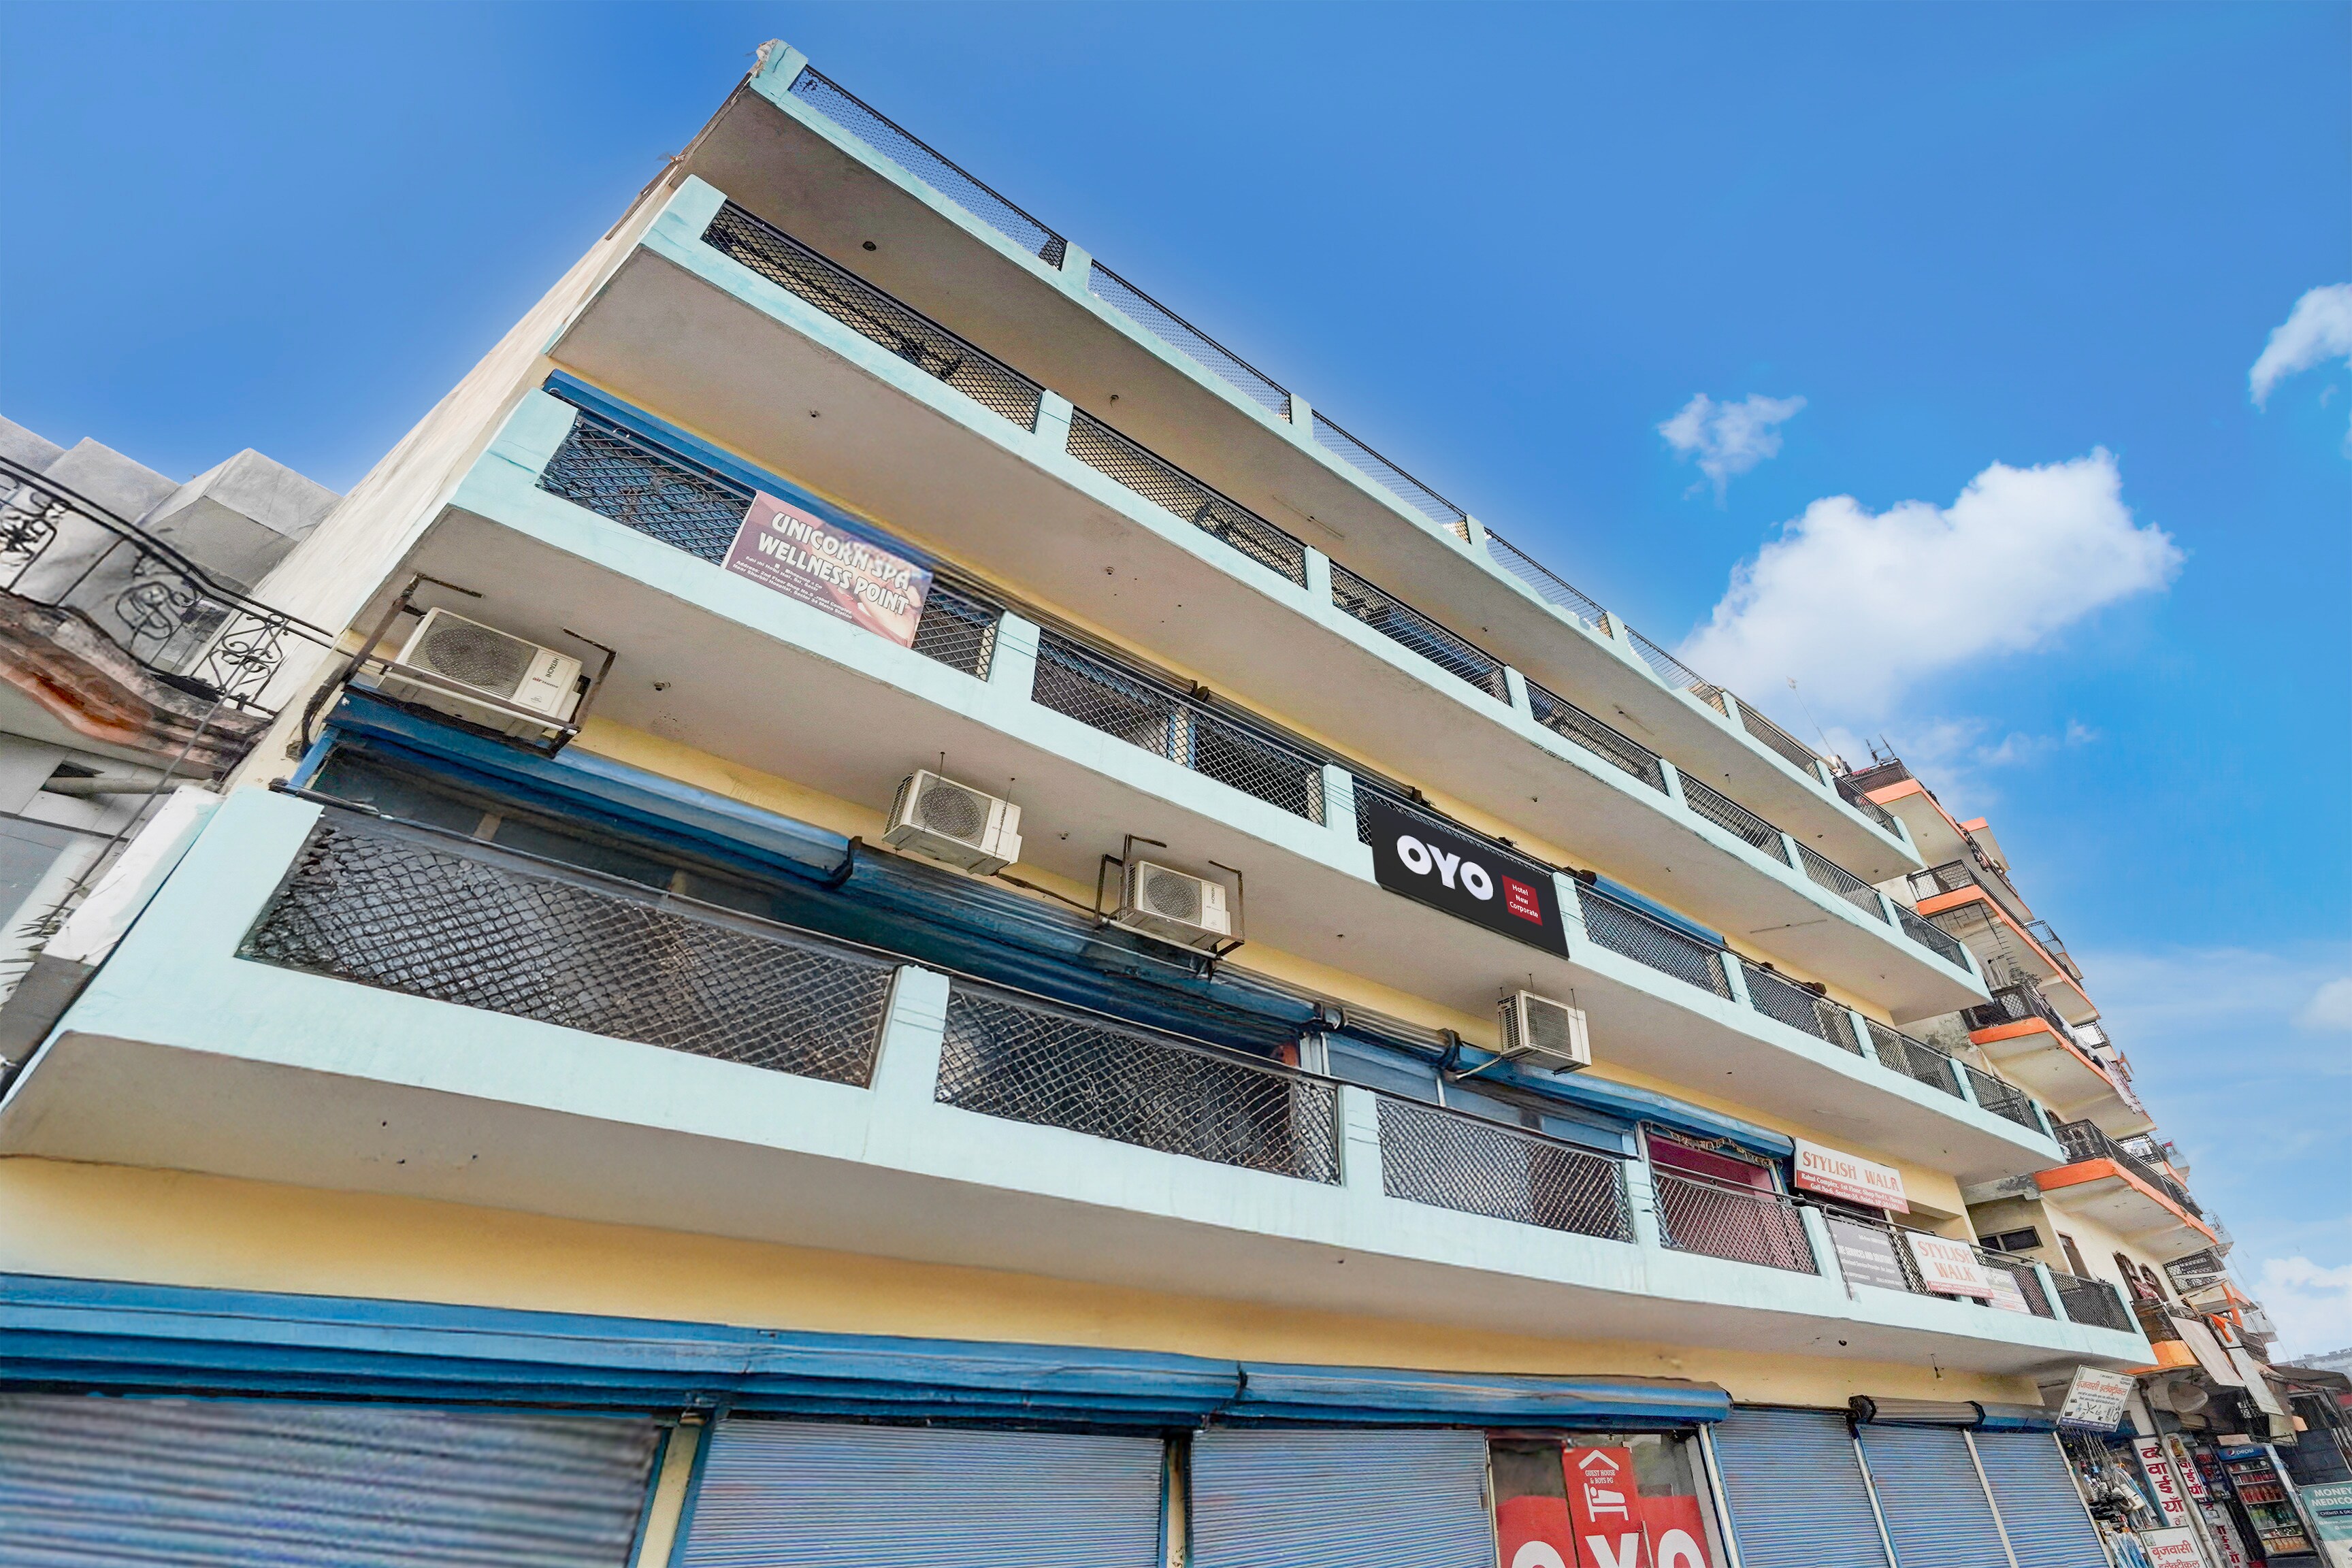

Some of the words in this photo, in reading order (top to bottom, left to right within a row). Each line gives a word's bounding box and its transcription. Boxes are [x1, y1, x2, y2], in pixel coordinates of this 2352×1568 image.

[772, 512, 870, 572] UNICORN
[871, 559, 911, 591] SPA
[758, 532, 853, 590] WELLNESS
[853, 576, 910, 615] POINT
[787, 582, 800, 591] Shop
[834, 608, 853, 619] Station
[545, 657, 560, 679] HITACHI
[1396, 835, 1494, 900] OYO
[1512, 884, 1529, 896] Hotel
[1515, 894, 1529, 905] New
[1509, 901, 1539, 918] Corporate
[1802, 1151, 1858, 1180] STYLISH
[1917, 1241, 1975, 1264] STYLISH
[1934, 1262, 1978, 1283] WALK
[2236, 1448, 2254, 1456] pepsi
[2314, 1487, 2352, 1497] MONEY
[2151, 1540, 2193, 1561] बृजवासी
